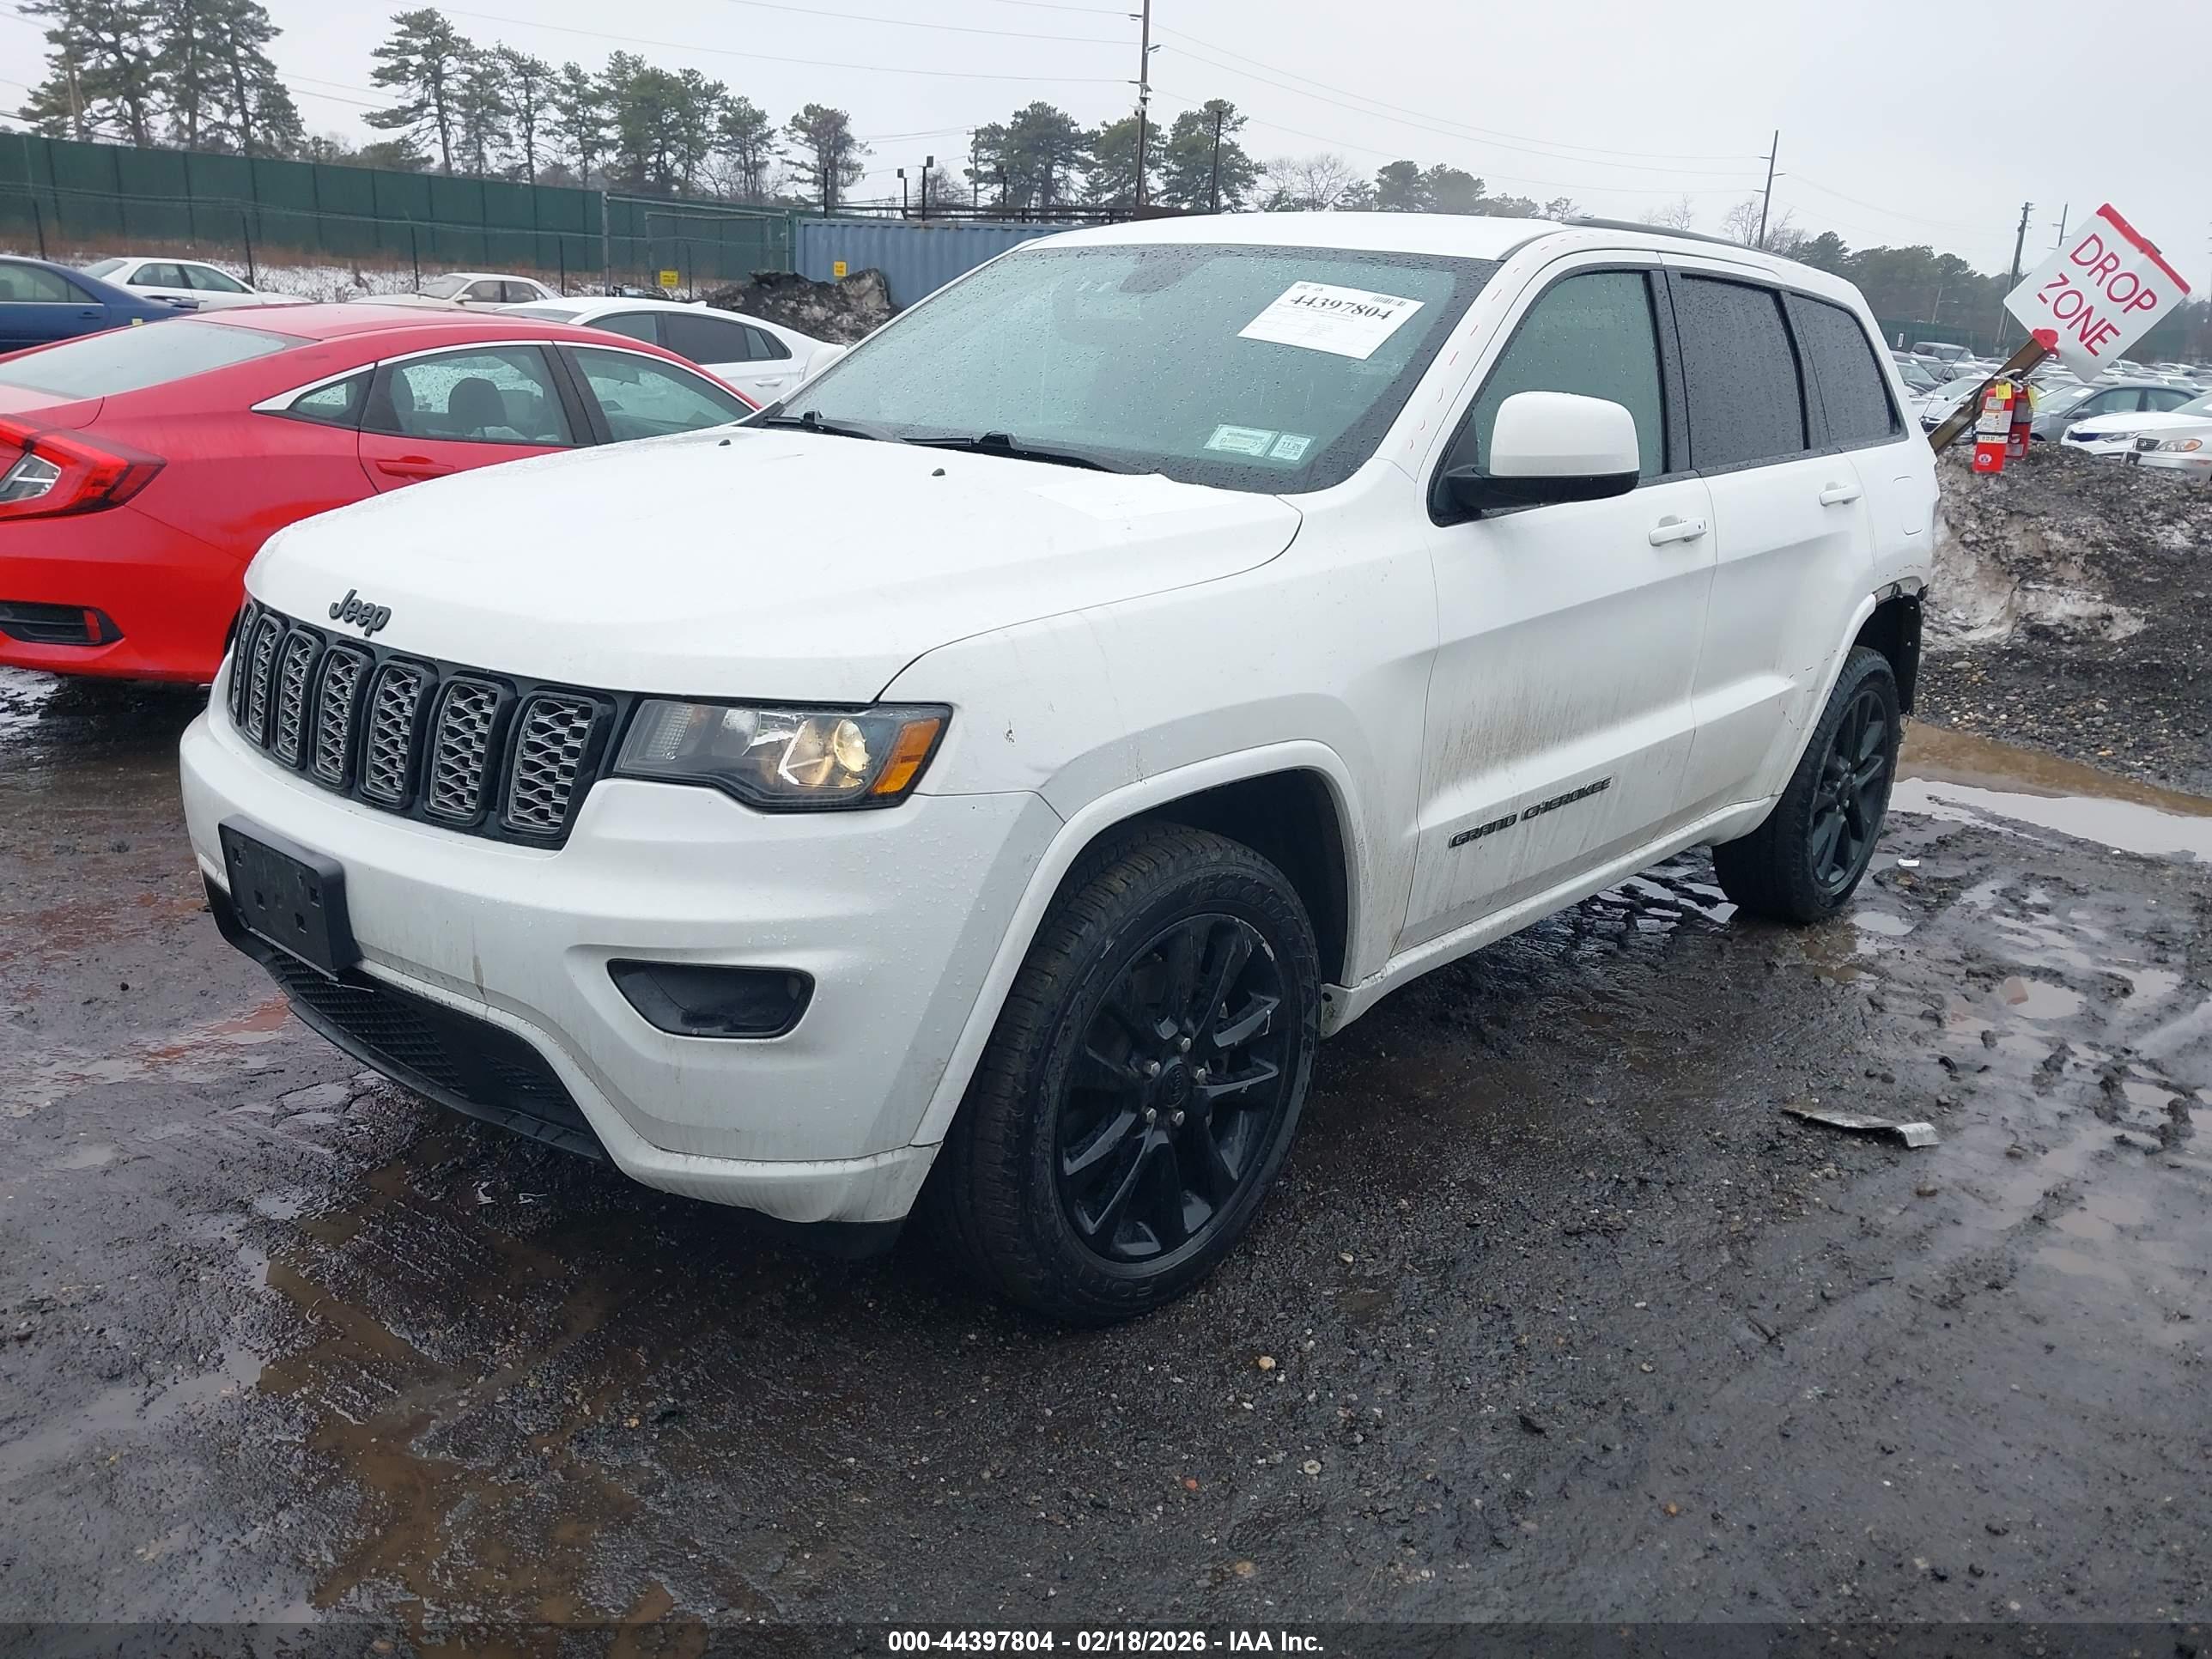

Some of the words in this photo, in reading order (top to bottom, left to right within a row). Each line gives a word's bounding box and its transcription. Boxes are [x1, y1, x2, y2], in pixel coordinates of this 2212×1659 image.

[1291, 294, 1395, 320] 44397804
[2069, 233, 2158, 314] DROP
[2037, 272, 2121, 357] ZONE
[329, 588, 392, 637] Jeep
[1449, 811, 1518, 848] GRAND
[1521, 775, 1614, 821] CHEROKEE
